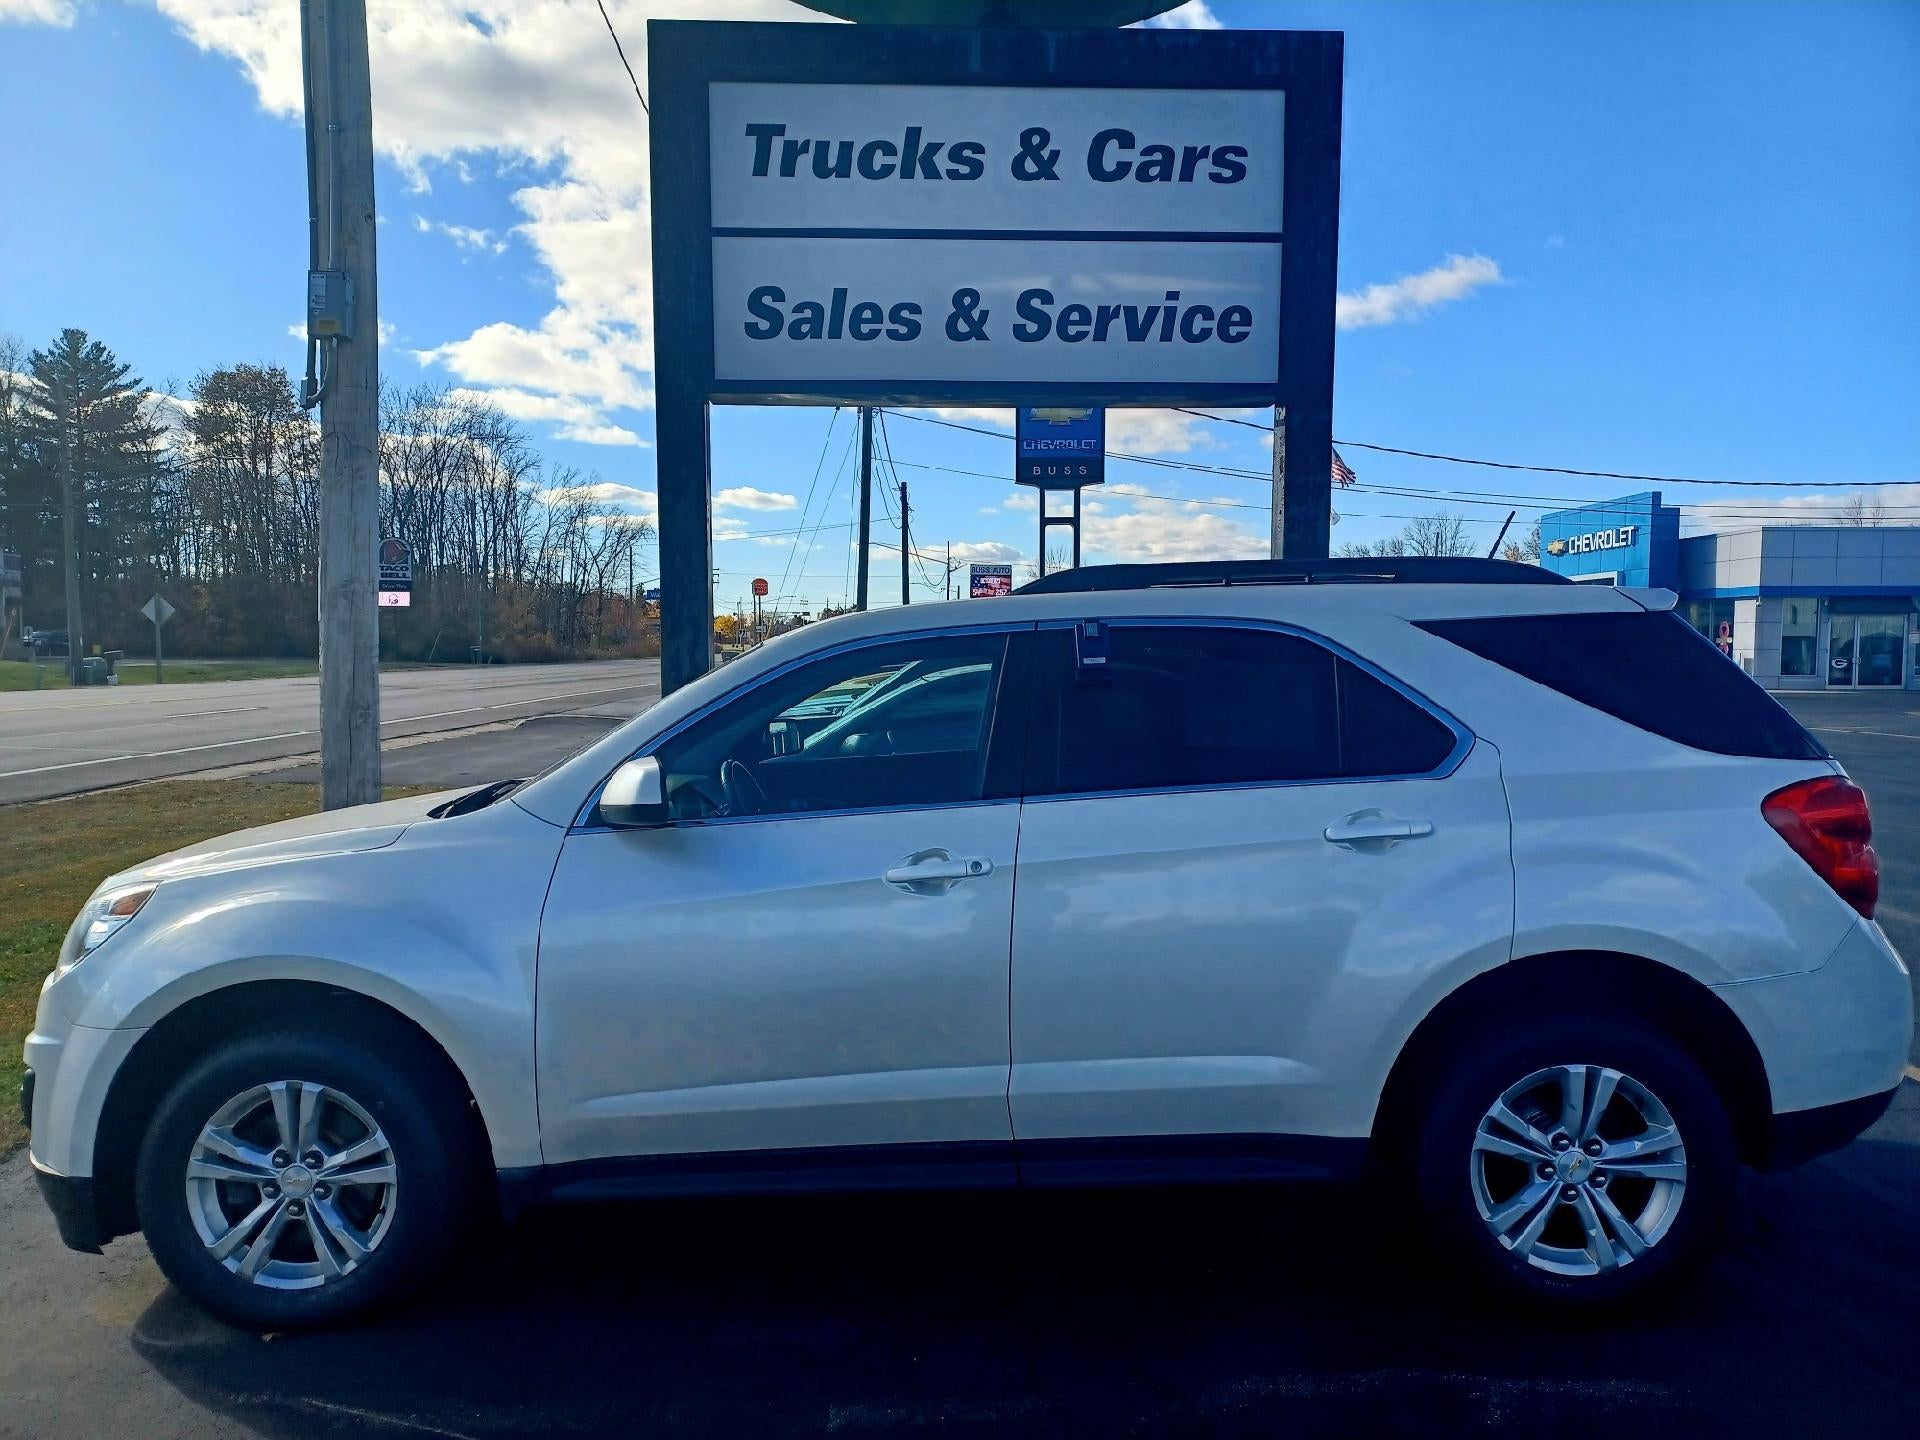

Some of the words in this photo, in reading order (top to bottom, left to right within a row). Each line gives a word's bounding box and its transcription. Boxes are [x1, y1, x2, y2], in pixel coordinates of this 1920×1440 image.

[744, 122, 986, 182] Trucks
[1010, 126, 1061, 182] &
[1086, 127, 1249, 185] Cars
[743, 285, 923, 344] Sales
[944, 287, 992, 344] &
[1012, 288, 1253, 345] Service
[1023, 439, 1097, 450] CHEVROLET
[1033, 466, 1087, 475] BUSS
[1568, 526, 1635, 554] CHEVROLET
